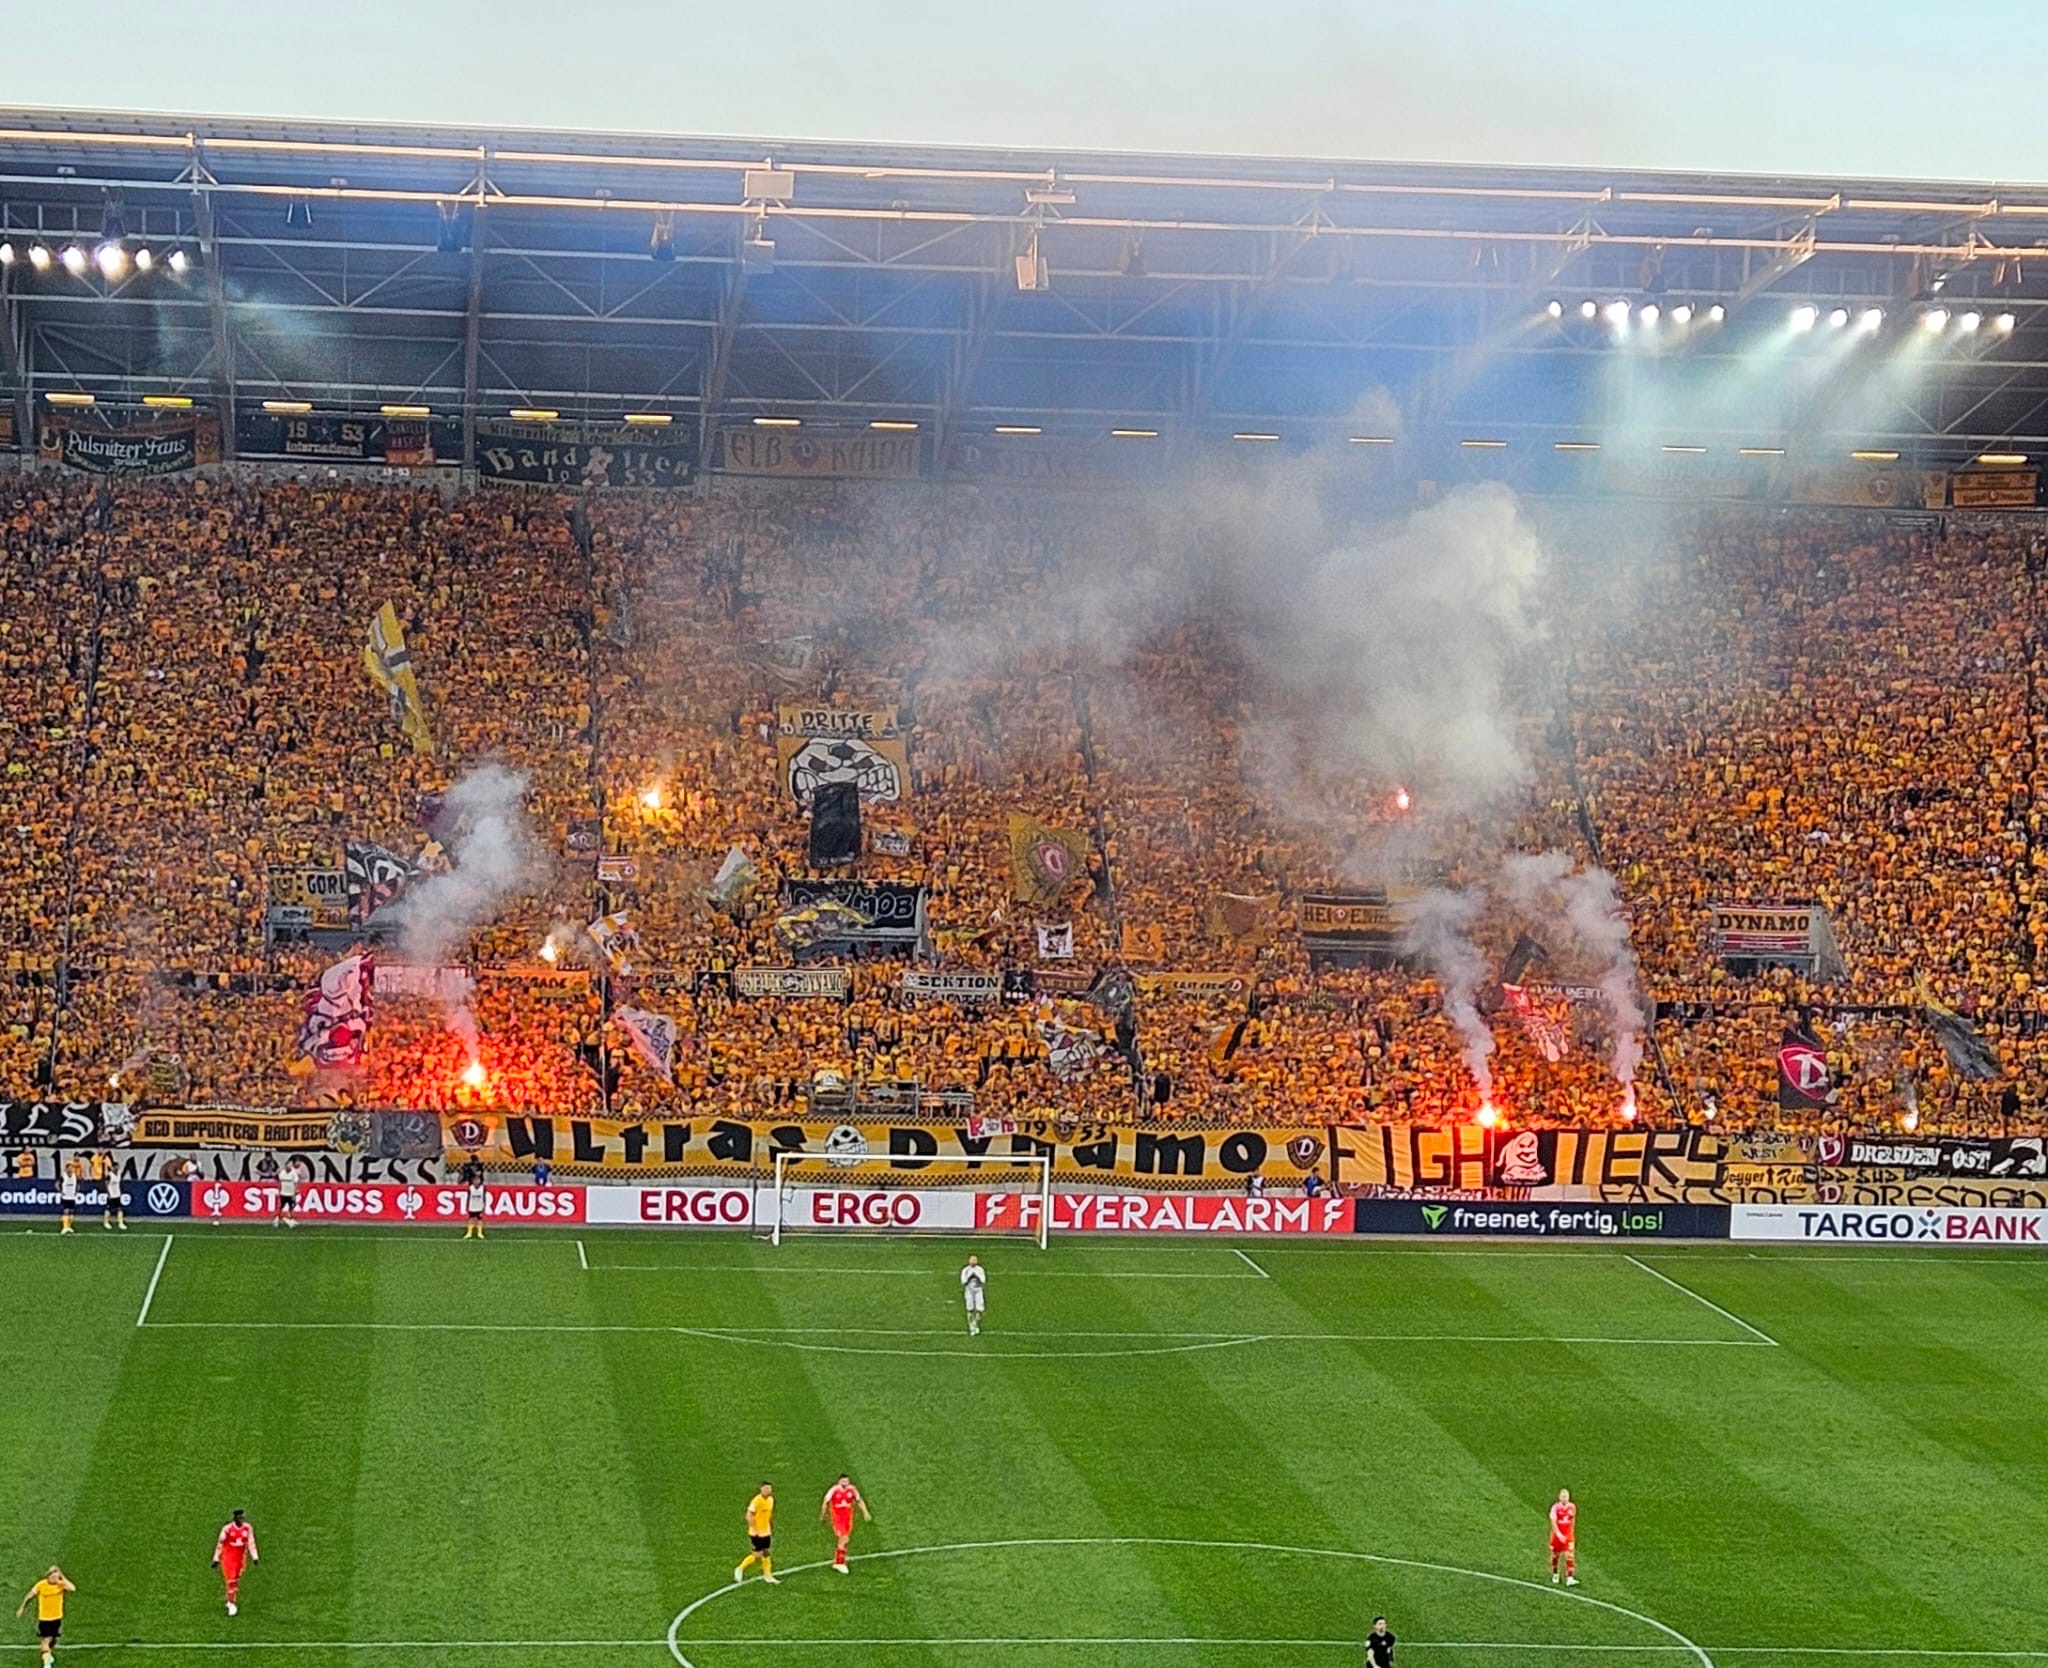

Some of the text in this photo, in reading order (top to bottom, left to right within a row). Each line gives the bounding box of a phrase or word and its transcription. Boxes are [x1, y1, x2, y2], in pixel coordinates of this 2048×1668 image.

[287, 422, 365, 441] 19 53
[143, 434, 187, 456] Fans
[801, 711, 873, 730] DRITTE
[1718, 914, 1810, 931] DYNAMO
[918, 975, 999, 988] SEKTION
[1024, 1121, 1046, 1136] 19
[1080, 1121, 1107, 1142] 53
[1951, 1147, 1991, 1171] OST
[639, 1190, 749, 1223] ERGO
[812, 1192, 921, 1225] ERGO
[1020, 1195, 1310, 1233] FLYERALARM
[1454, 1208, 1663, 1234] freenet, fertig, los!
